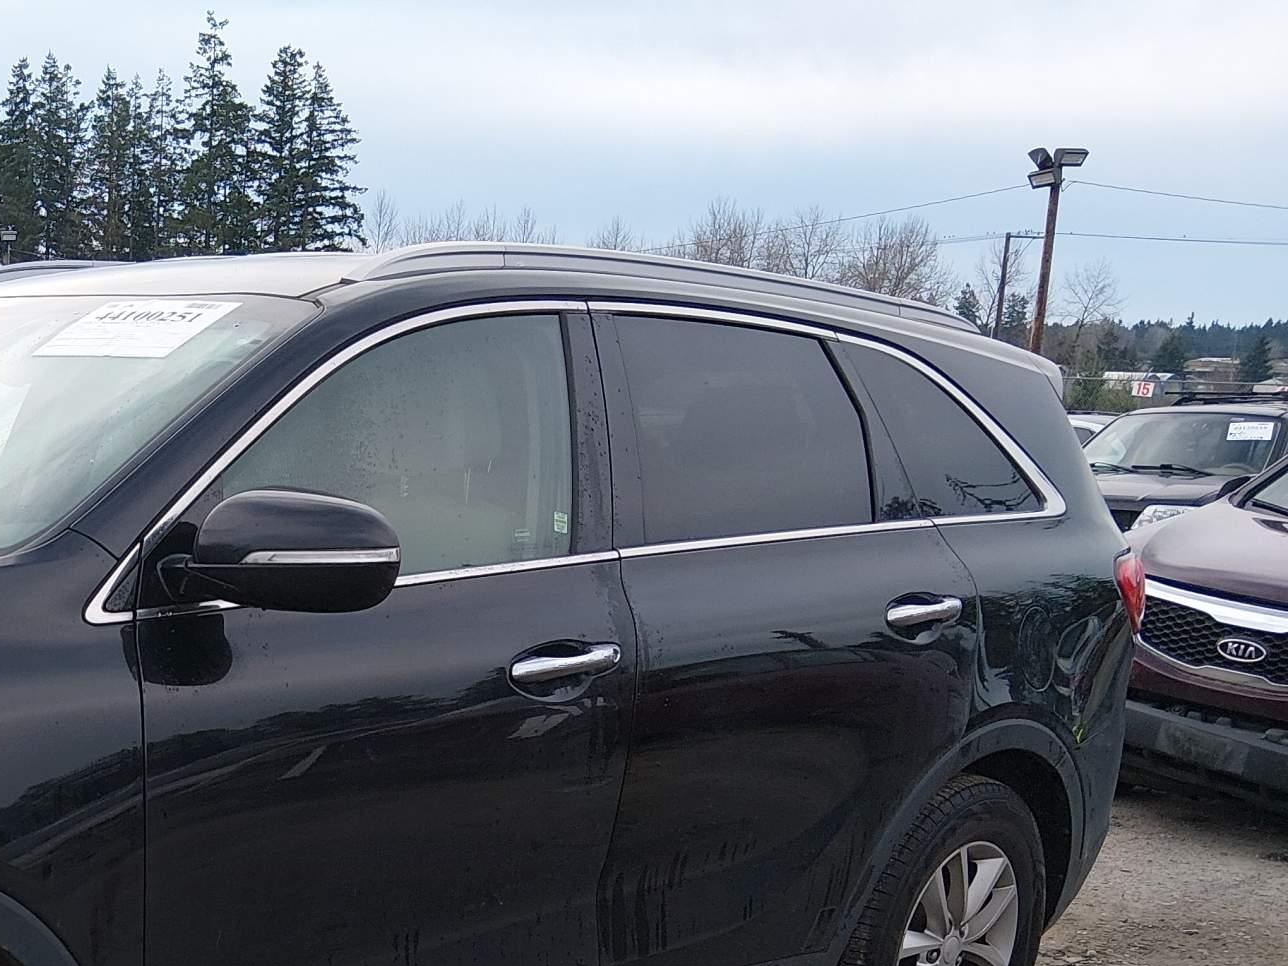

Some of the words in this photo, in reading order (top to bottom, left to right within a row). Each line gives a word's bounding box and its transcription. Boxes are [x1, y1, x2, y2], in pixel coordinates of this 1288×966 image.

[95, 310, 203, 323] 44100251
[1136, 382, 1151, 396] 15
[1226, 642, 1256, 659] KIA
